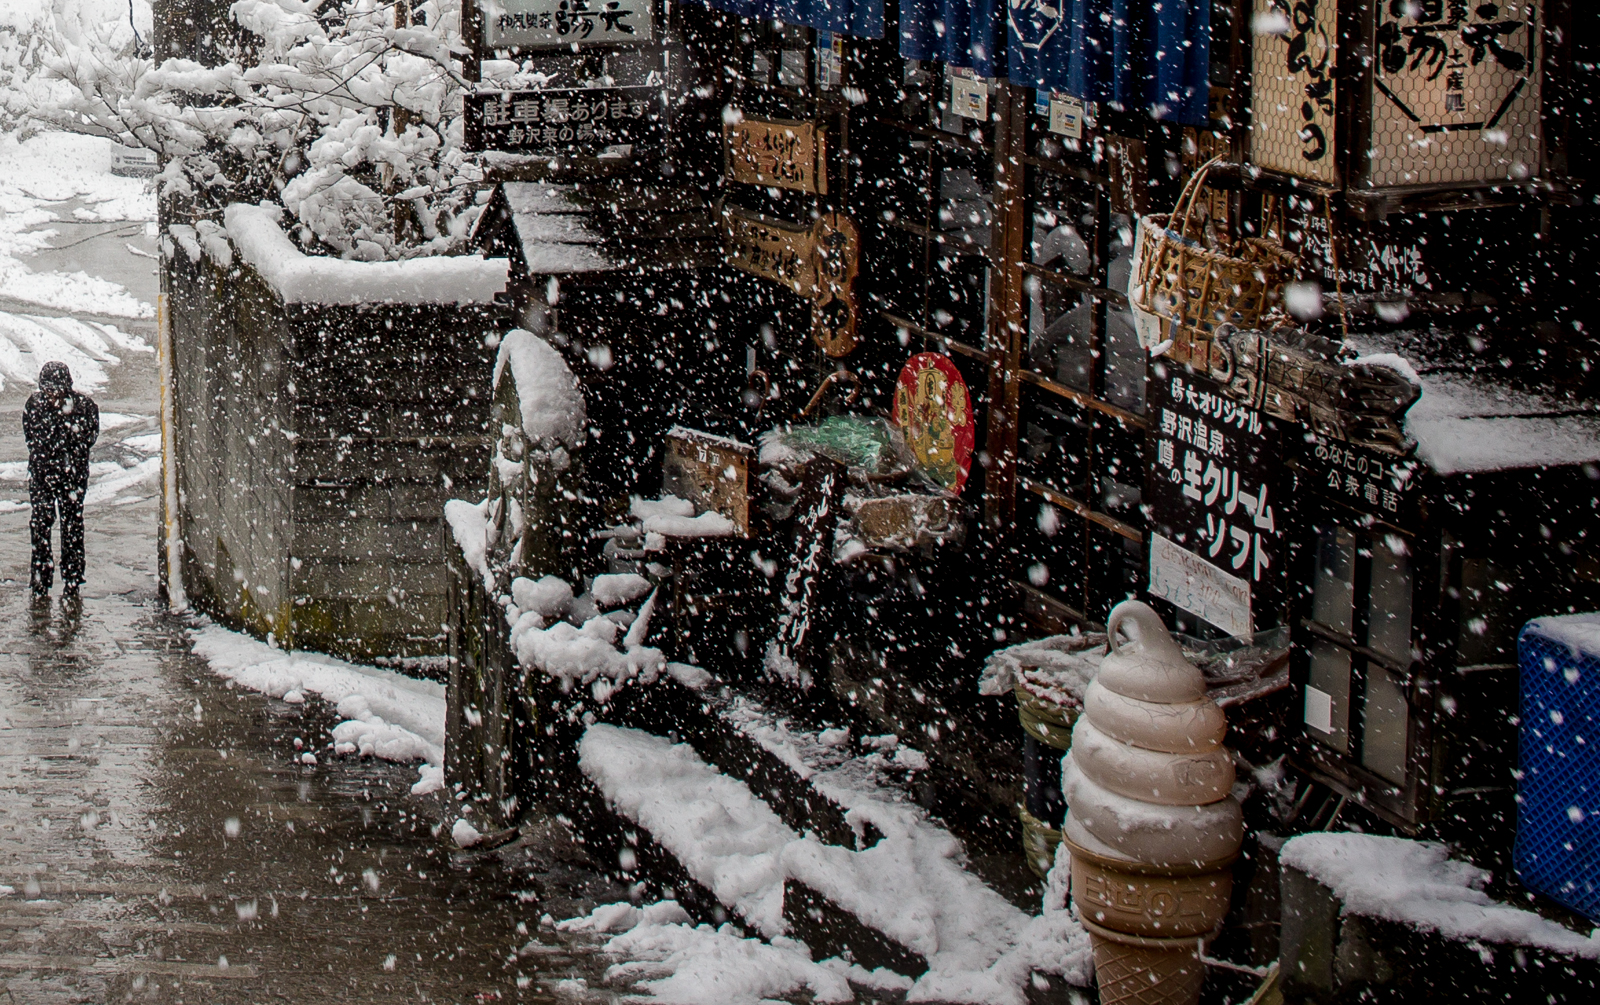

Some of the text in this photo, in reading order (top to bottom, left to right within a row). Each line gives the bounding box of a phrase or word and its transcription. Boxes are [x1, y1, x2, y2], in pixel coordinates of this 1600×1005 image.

[483, 98, 646, 126] 駐車場あります
[1160, 407, 1225, 458] 野沢温泉
[1182, 449, 1275, 534] 生クリーム
[1327, 468, 1399, 513] 公衆電話
[1206, 512, 1270, 582] ソフト
